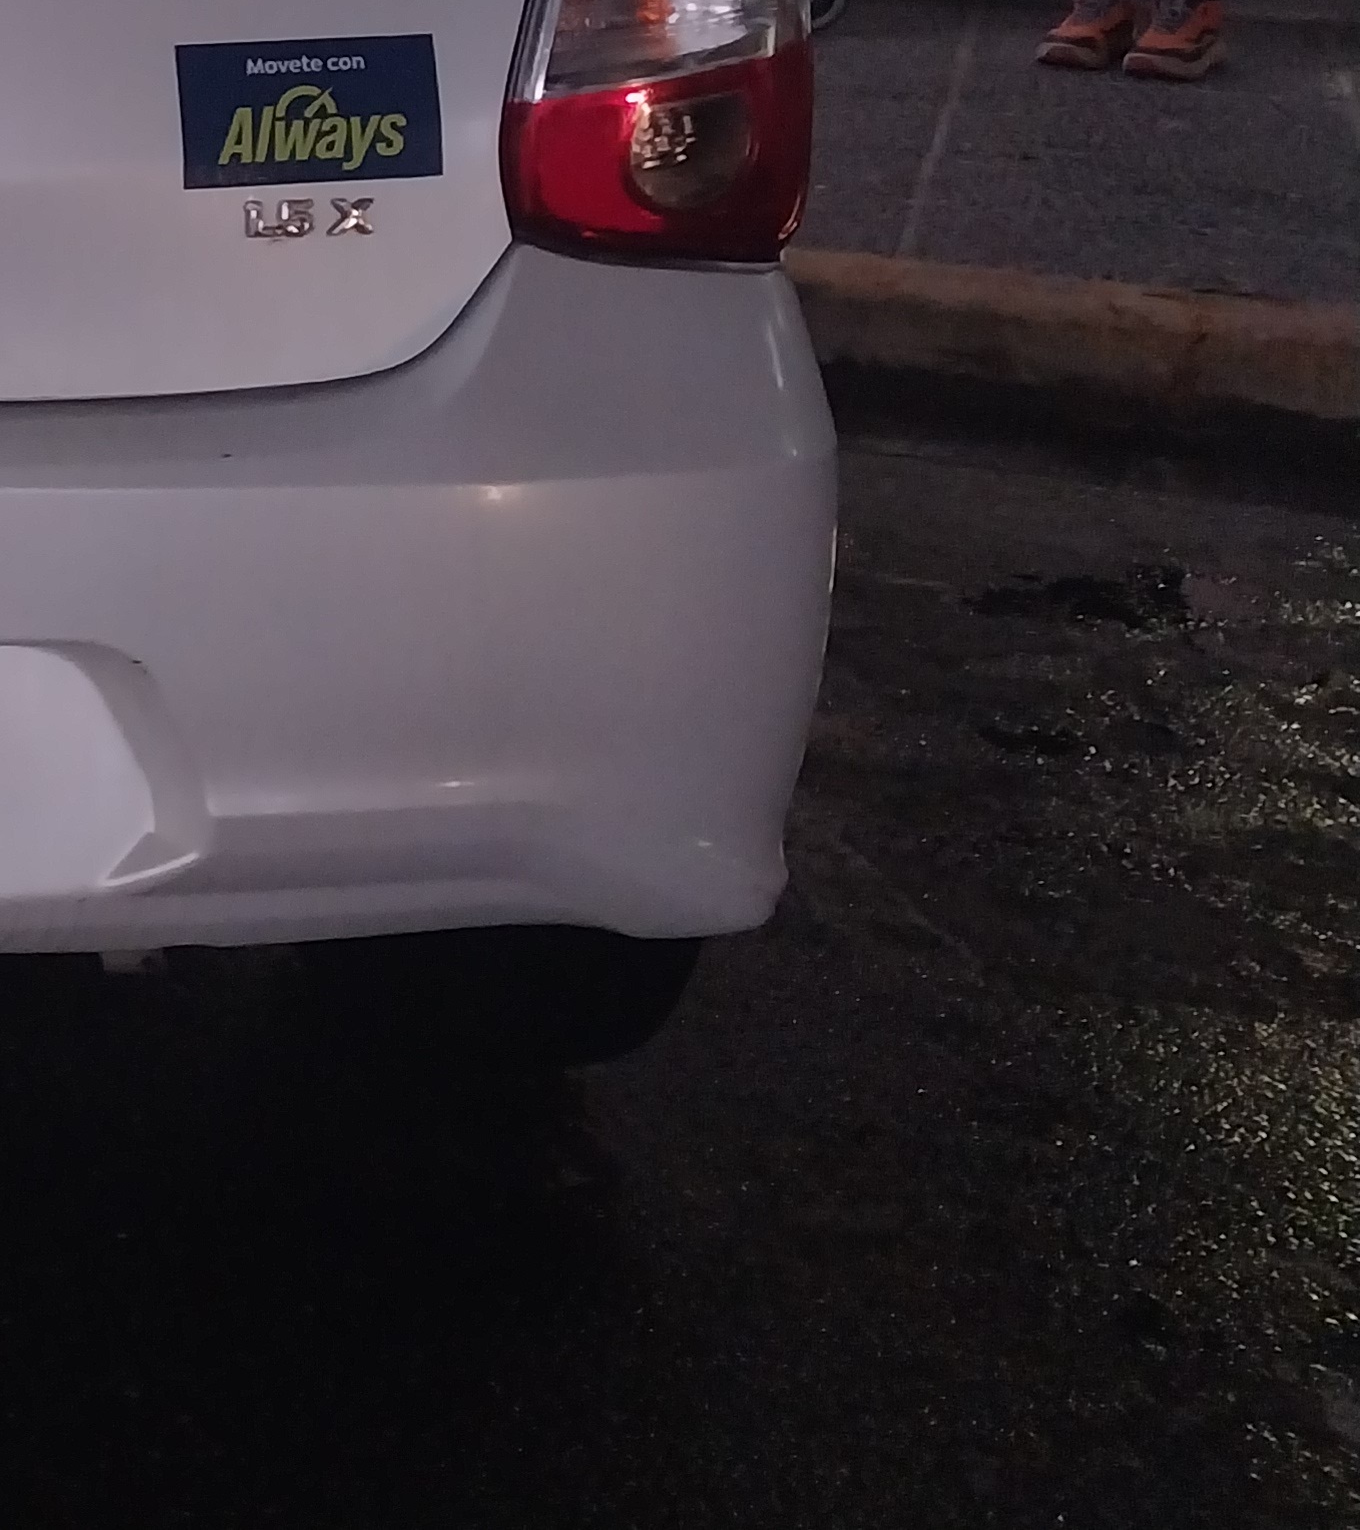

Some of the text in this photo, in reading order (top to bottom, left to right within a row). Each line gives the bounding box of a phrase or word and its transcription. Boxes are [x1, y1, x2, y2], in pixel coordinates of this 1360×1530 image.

[246, 54, 366, 76] Movete con
[218, 105, 408, 170] Always
[326, 197, 375, 236] X
